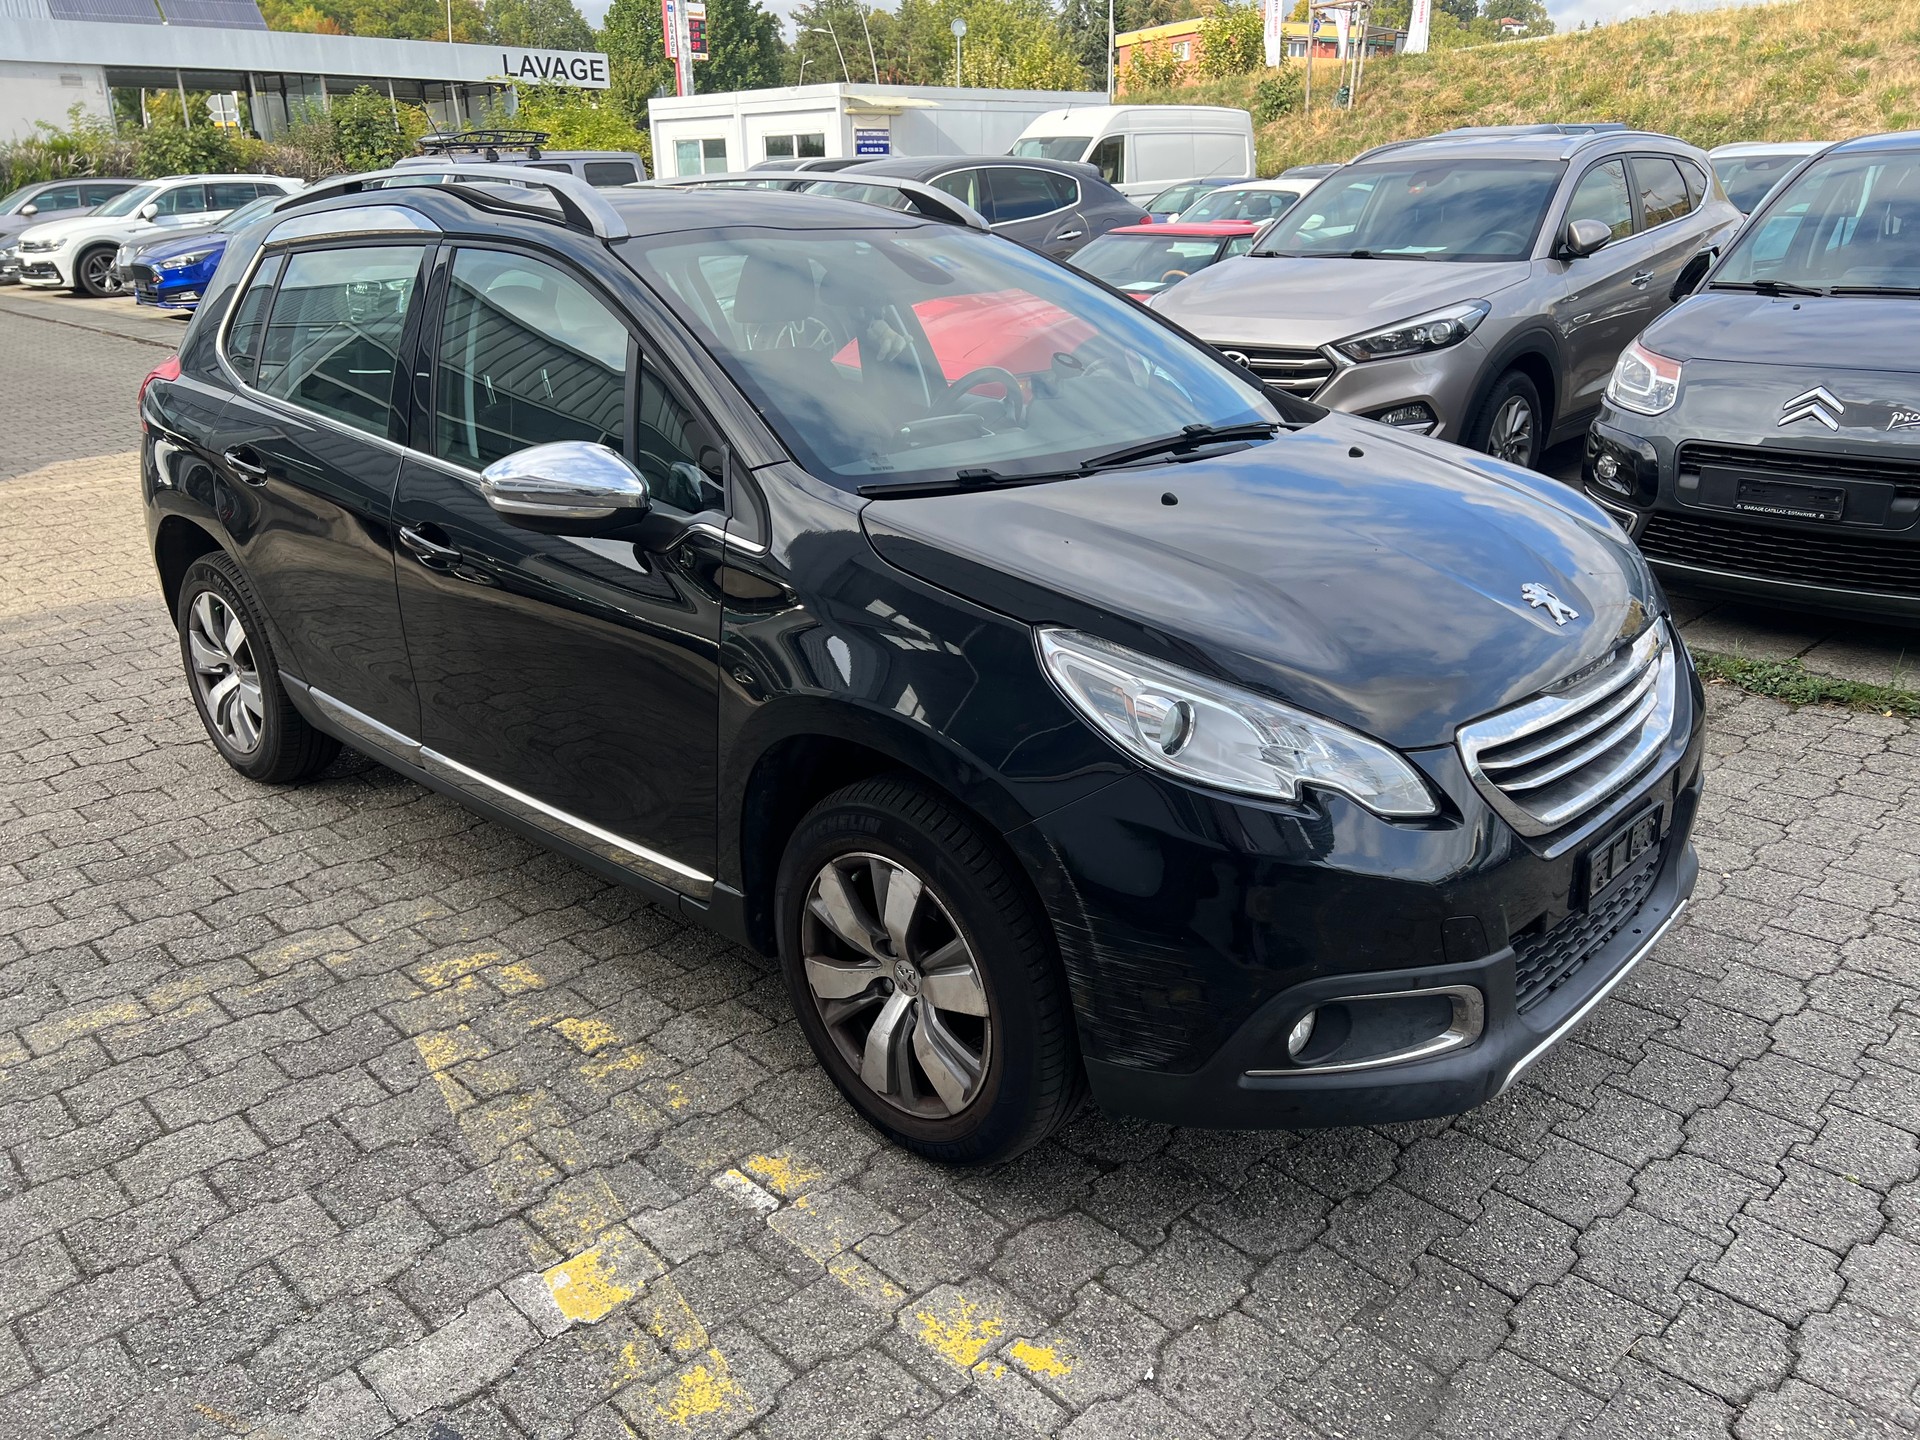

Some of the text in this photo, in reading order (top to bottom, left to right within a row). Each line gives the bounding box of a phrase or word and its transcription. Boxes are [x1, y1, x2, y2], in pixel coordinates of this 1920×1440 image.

[668, 16, 676, 54] LAVAGE
[502, 54, 605, 82] LAVAGE
[1886, 412, 1920, 431] Pic
